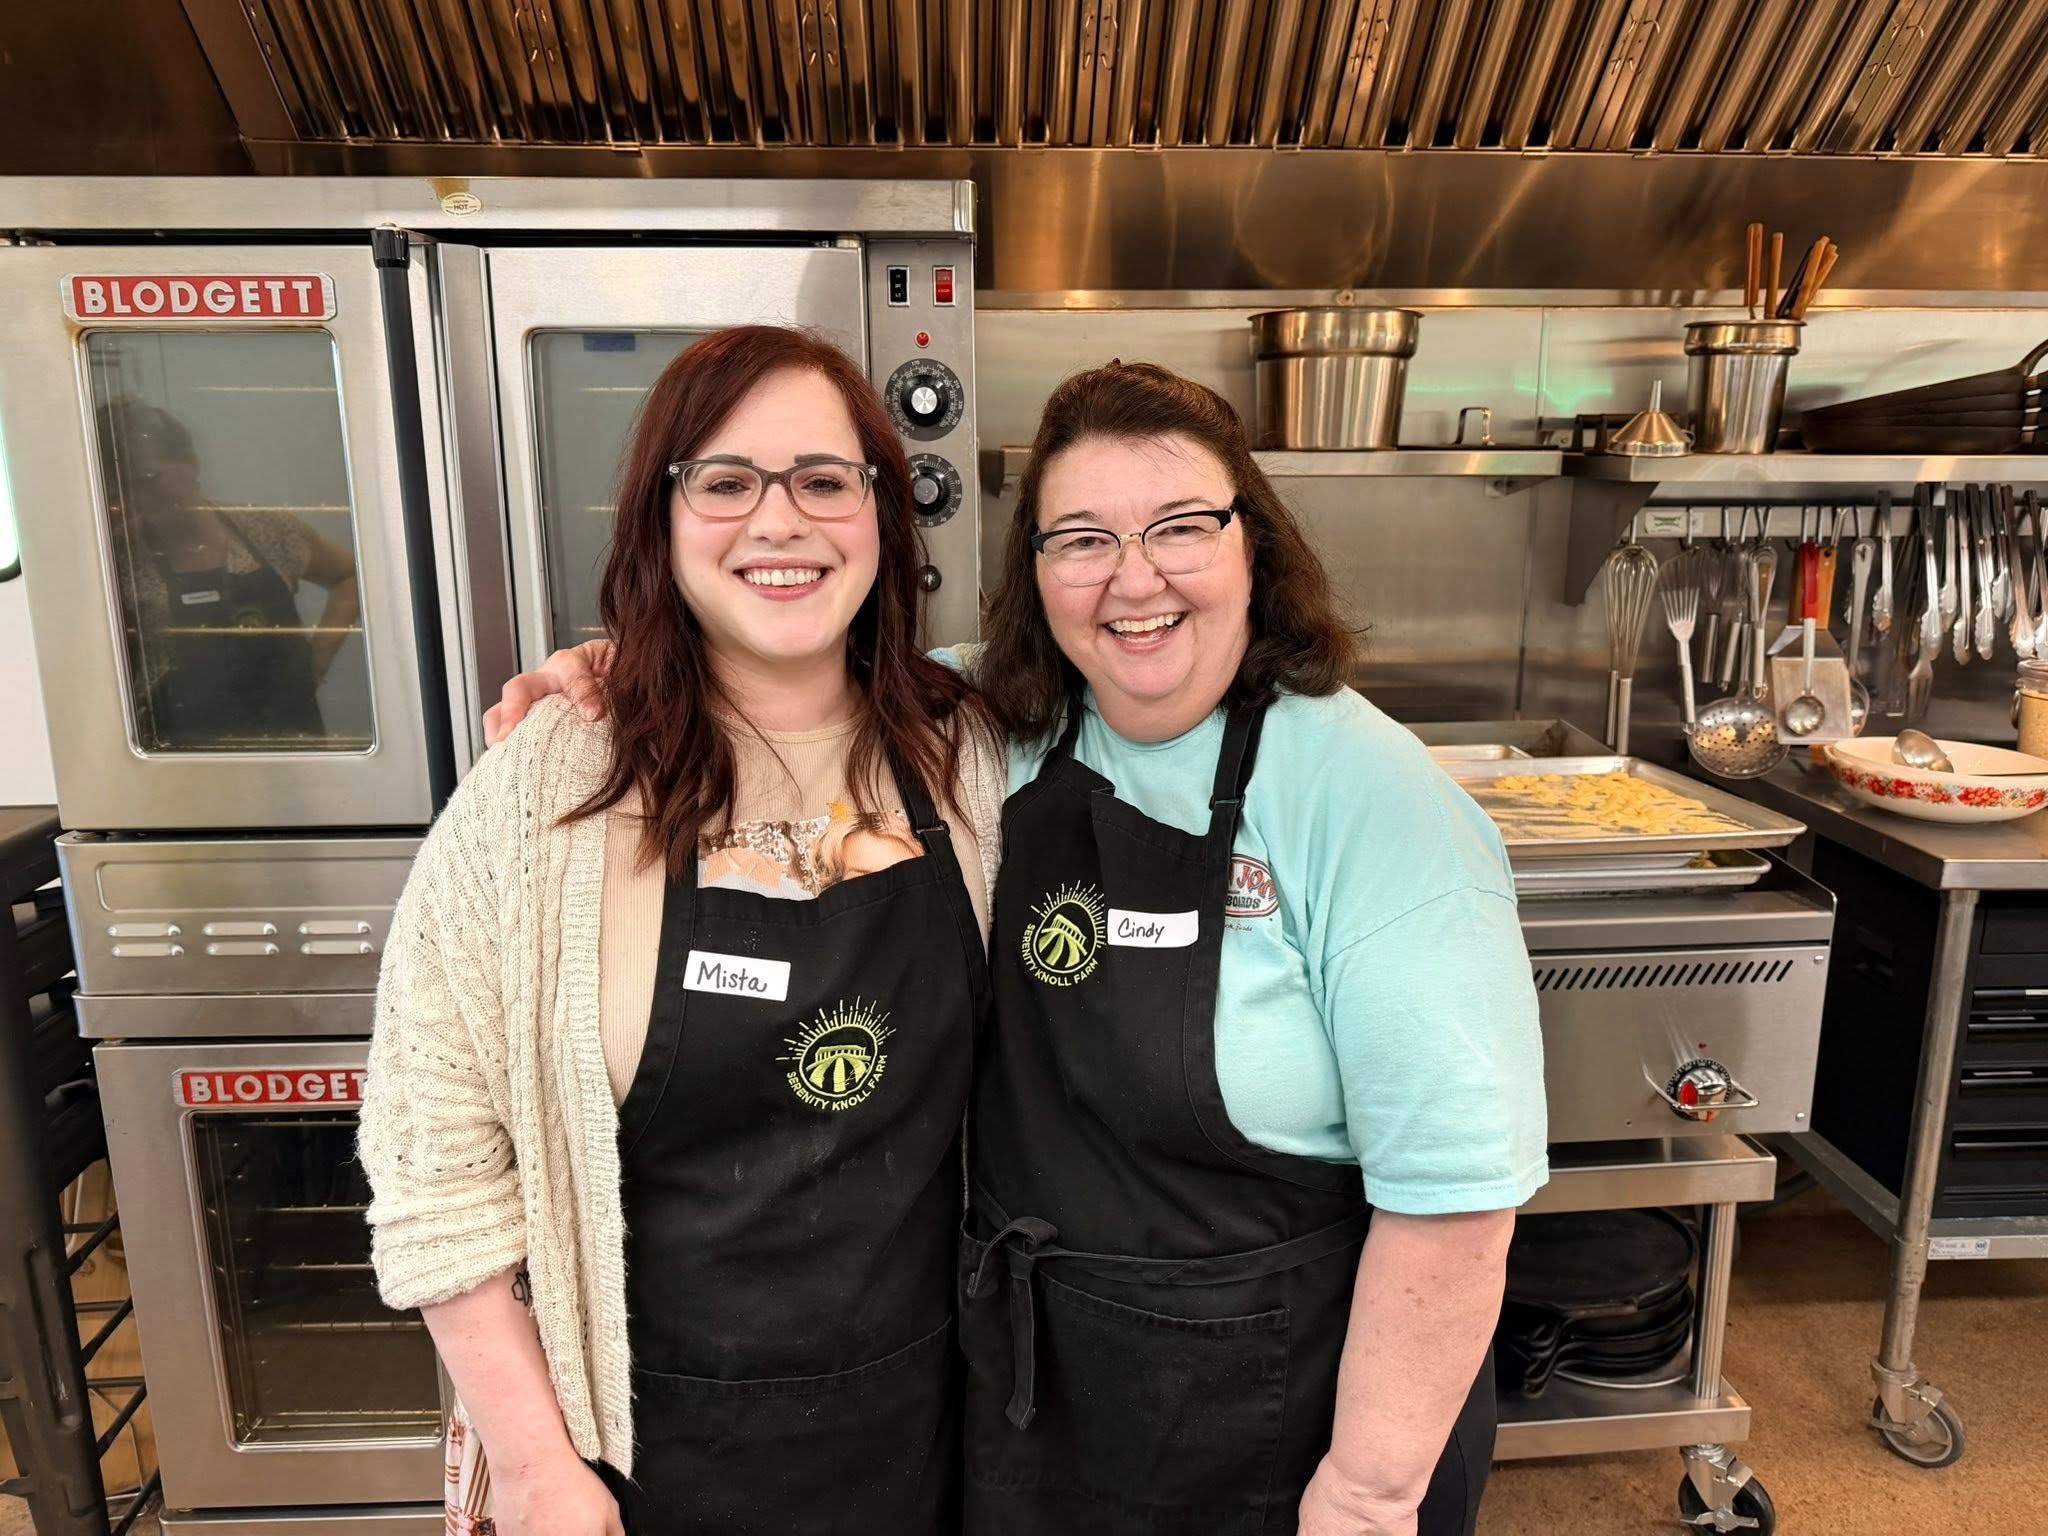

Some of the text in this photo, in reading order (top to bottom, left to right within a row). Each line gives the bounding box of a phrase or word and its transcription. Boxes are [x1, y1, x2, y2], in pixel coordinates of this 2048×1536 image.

[81, 279, 313, 315] BLODGETT
[1117, 918, 1166, 944] Cindy
[1021, 923, 1099, 986] SERENITY KNOLL FARM
[696, 960, 768, 993] Mista
[189, 1072, 368, 1102] BLODGET
[786, 1054, 888, 1111] SERENITY KNOLL FARM
